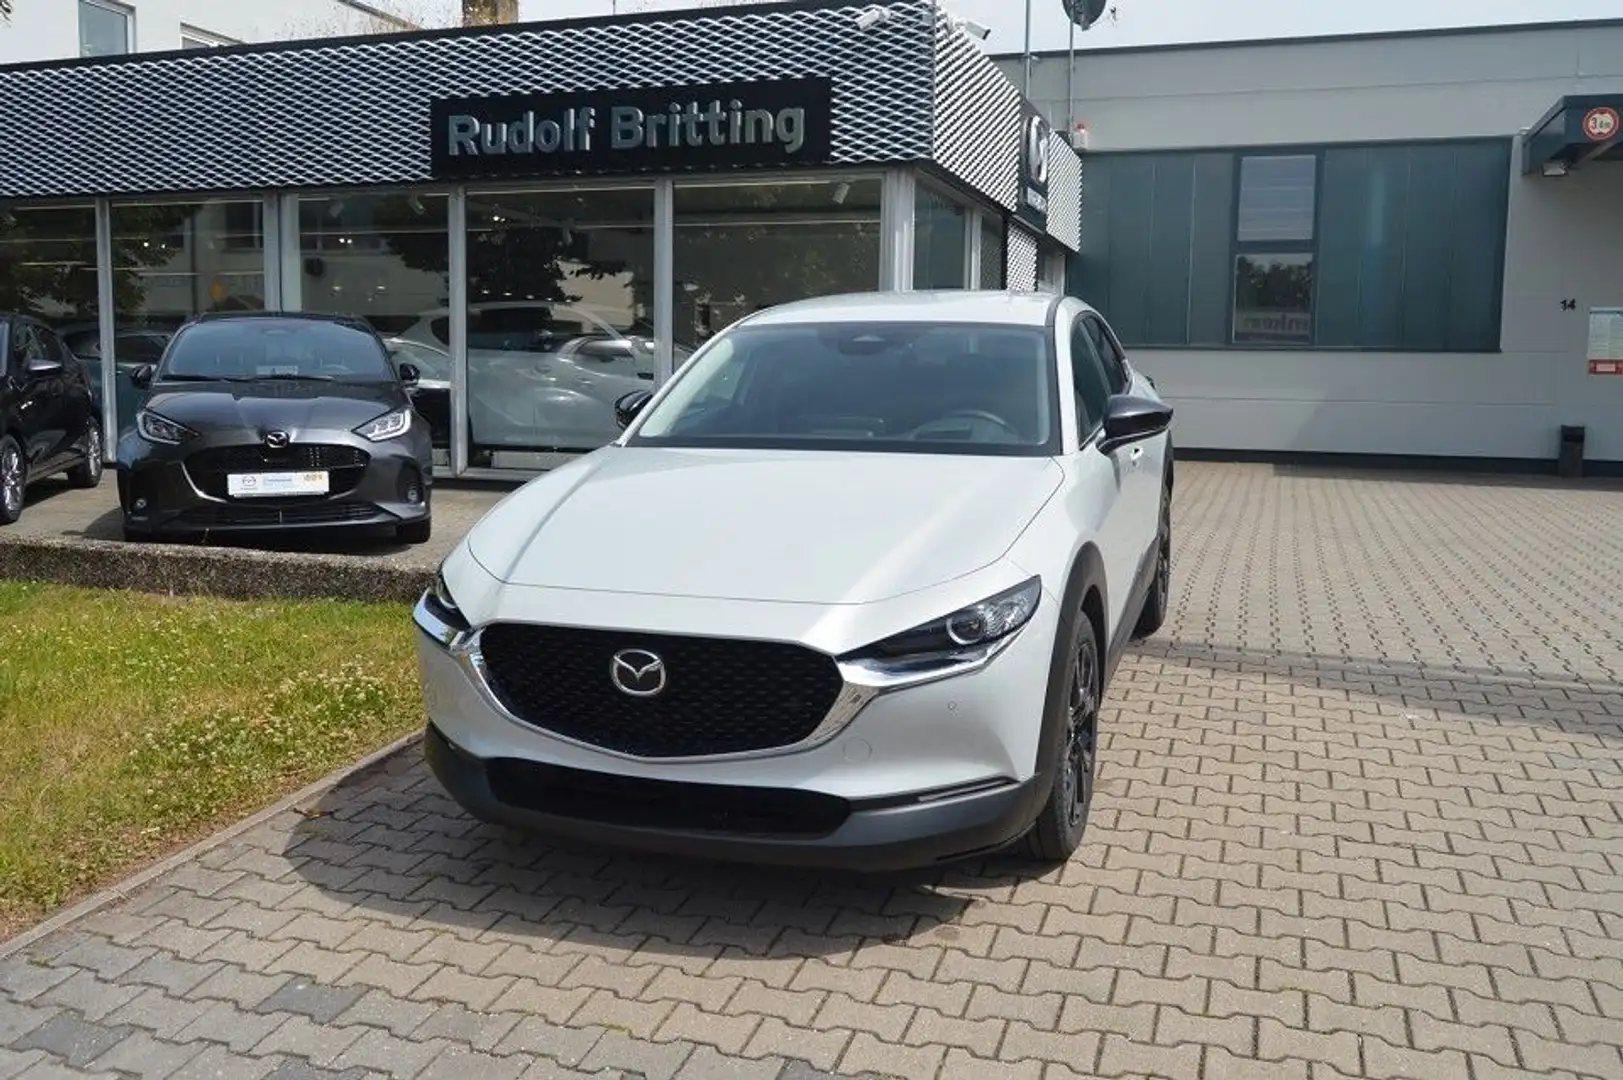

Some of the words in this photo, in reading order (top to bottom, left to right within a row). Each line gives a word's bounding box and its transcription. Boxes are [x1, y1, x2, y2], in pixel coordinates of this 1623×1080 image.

[448, 107, 596, 156] Rudolf
[610, 99, 806, 154] Britting
[1560, 299, 1576, 311] 14
